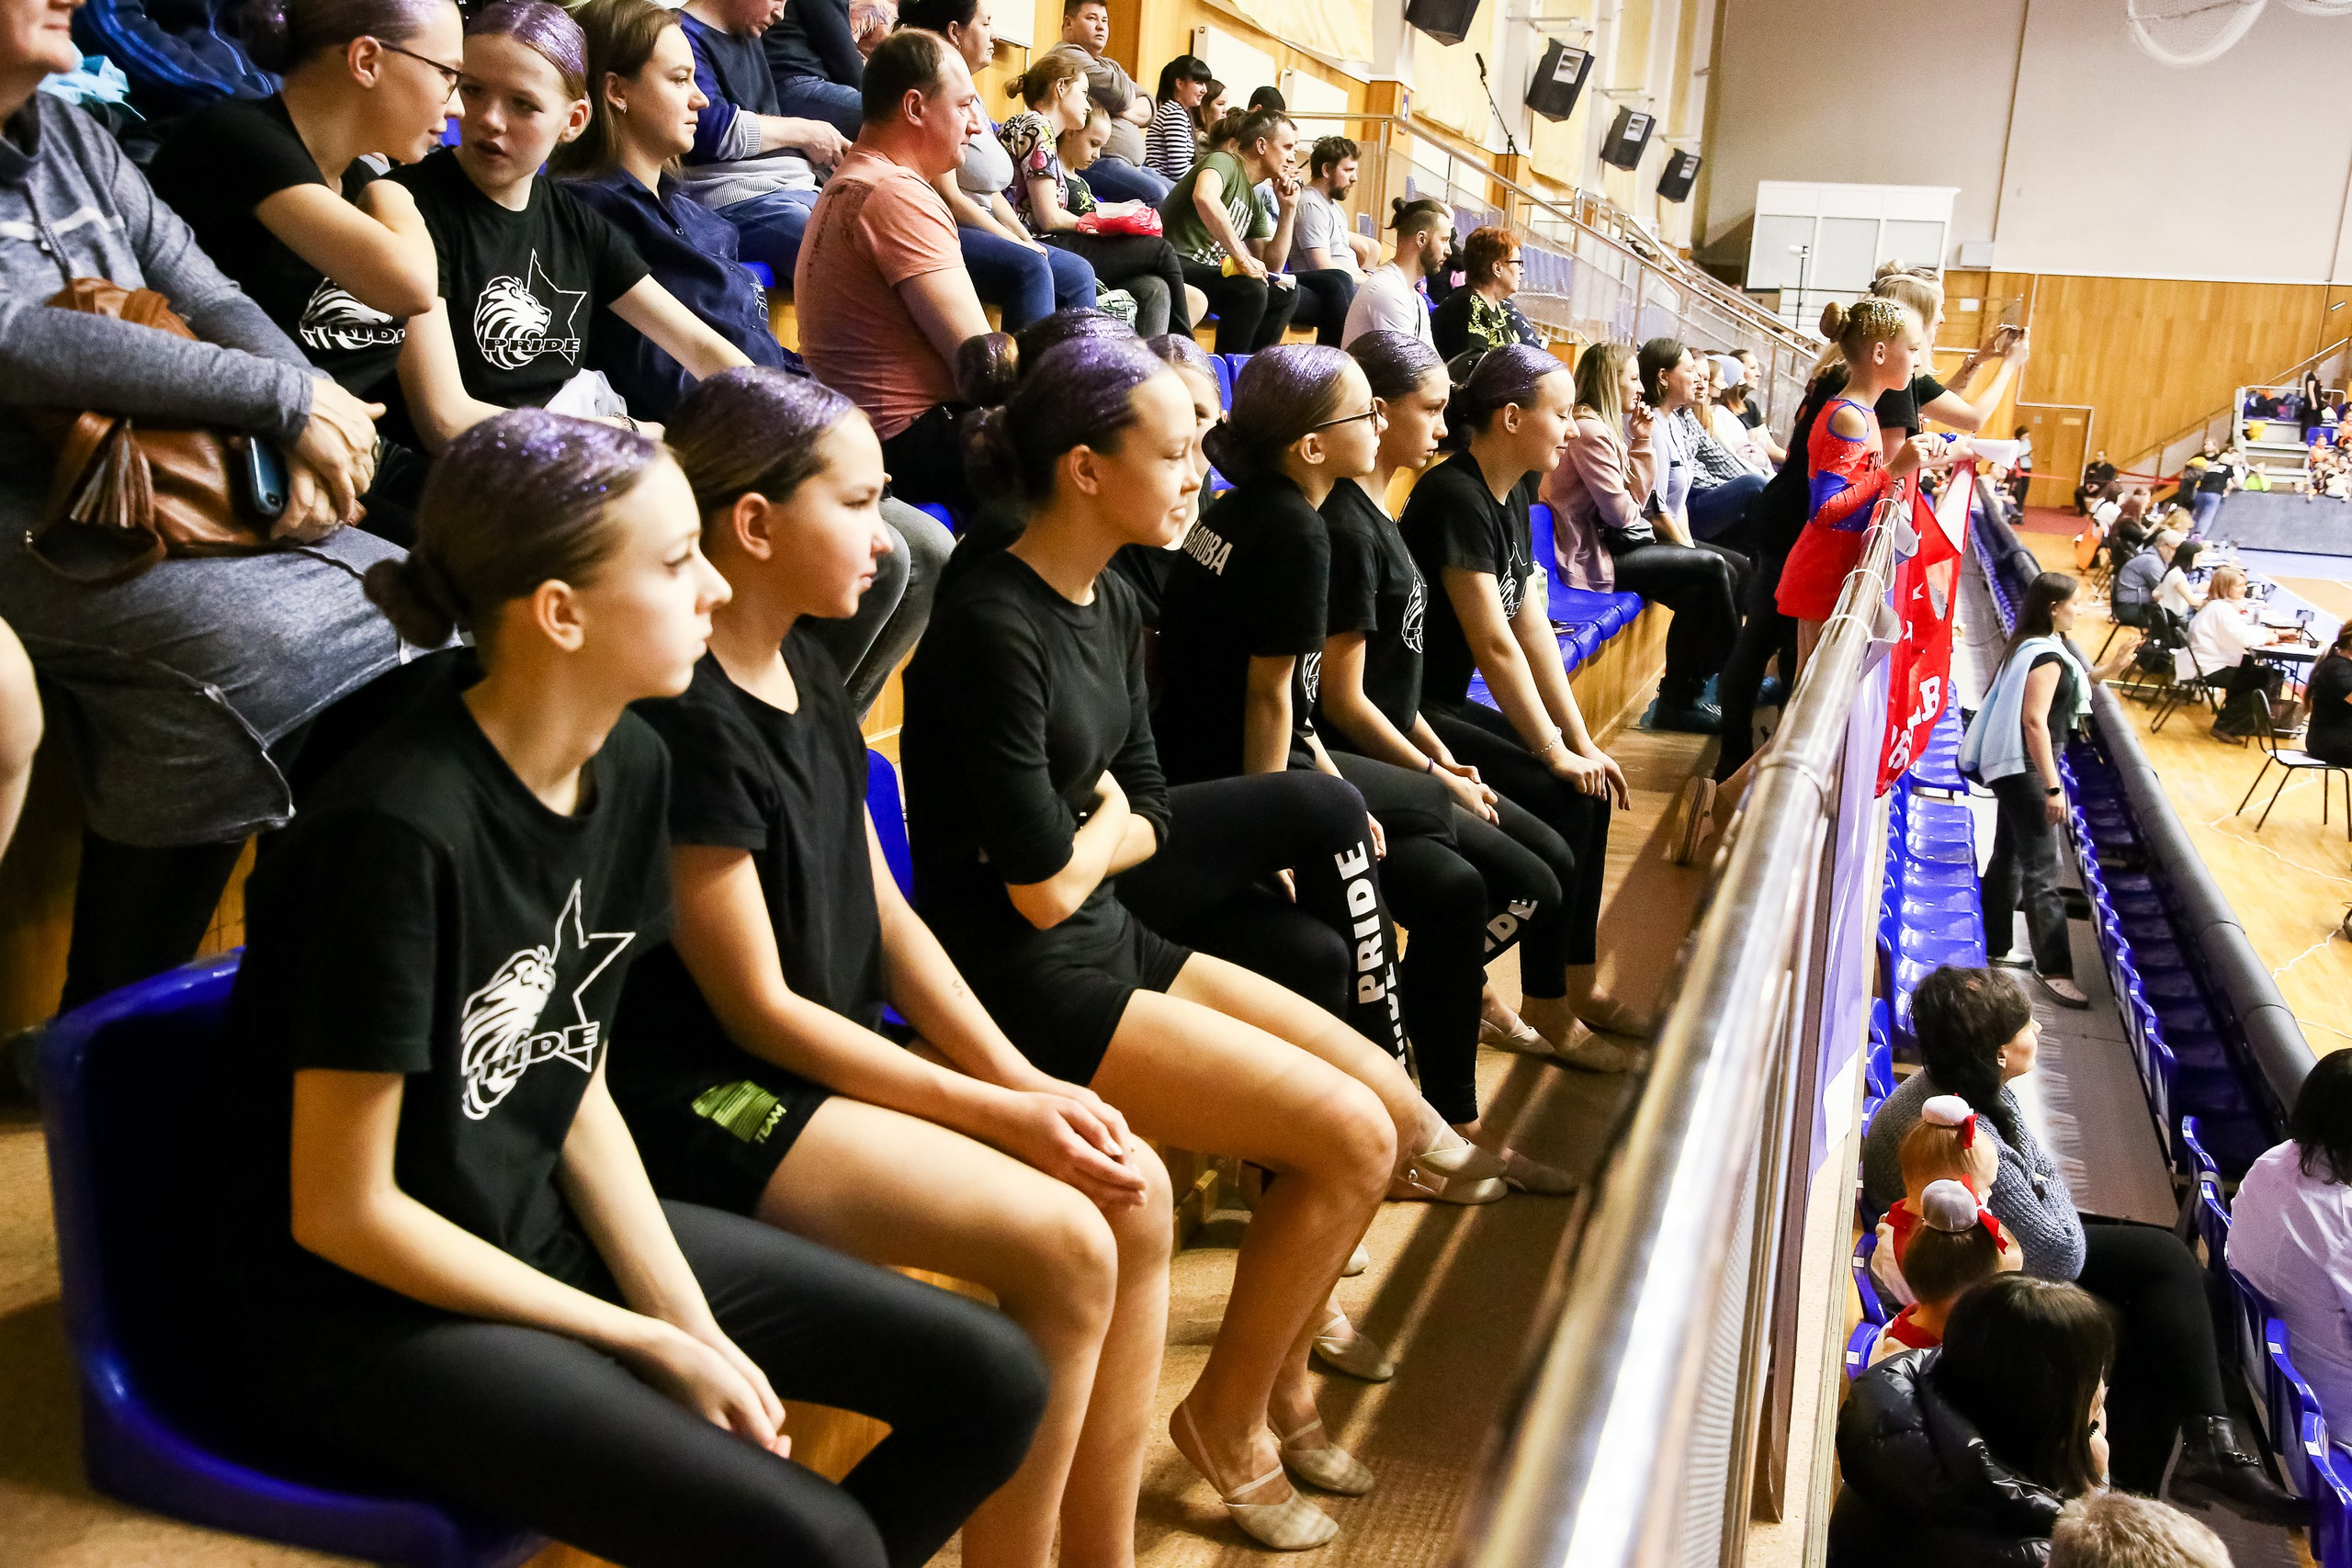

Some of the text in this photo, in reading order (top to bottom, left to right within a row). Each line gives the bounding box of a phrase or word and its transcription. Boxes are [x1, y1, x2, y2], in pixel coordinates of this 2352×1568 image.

[484, 337, 581, 353] PRIDE
[1334, 840, 1385, 1004] PRIDE
[1484, 899, 1538, 953] IDE
